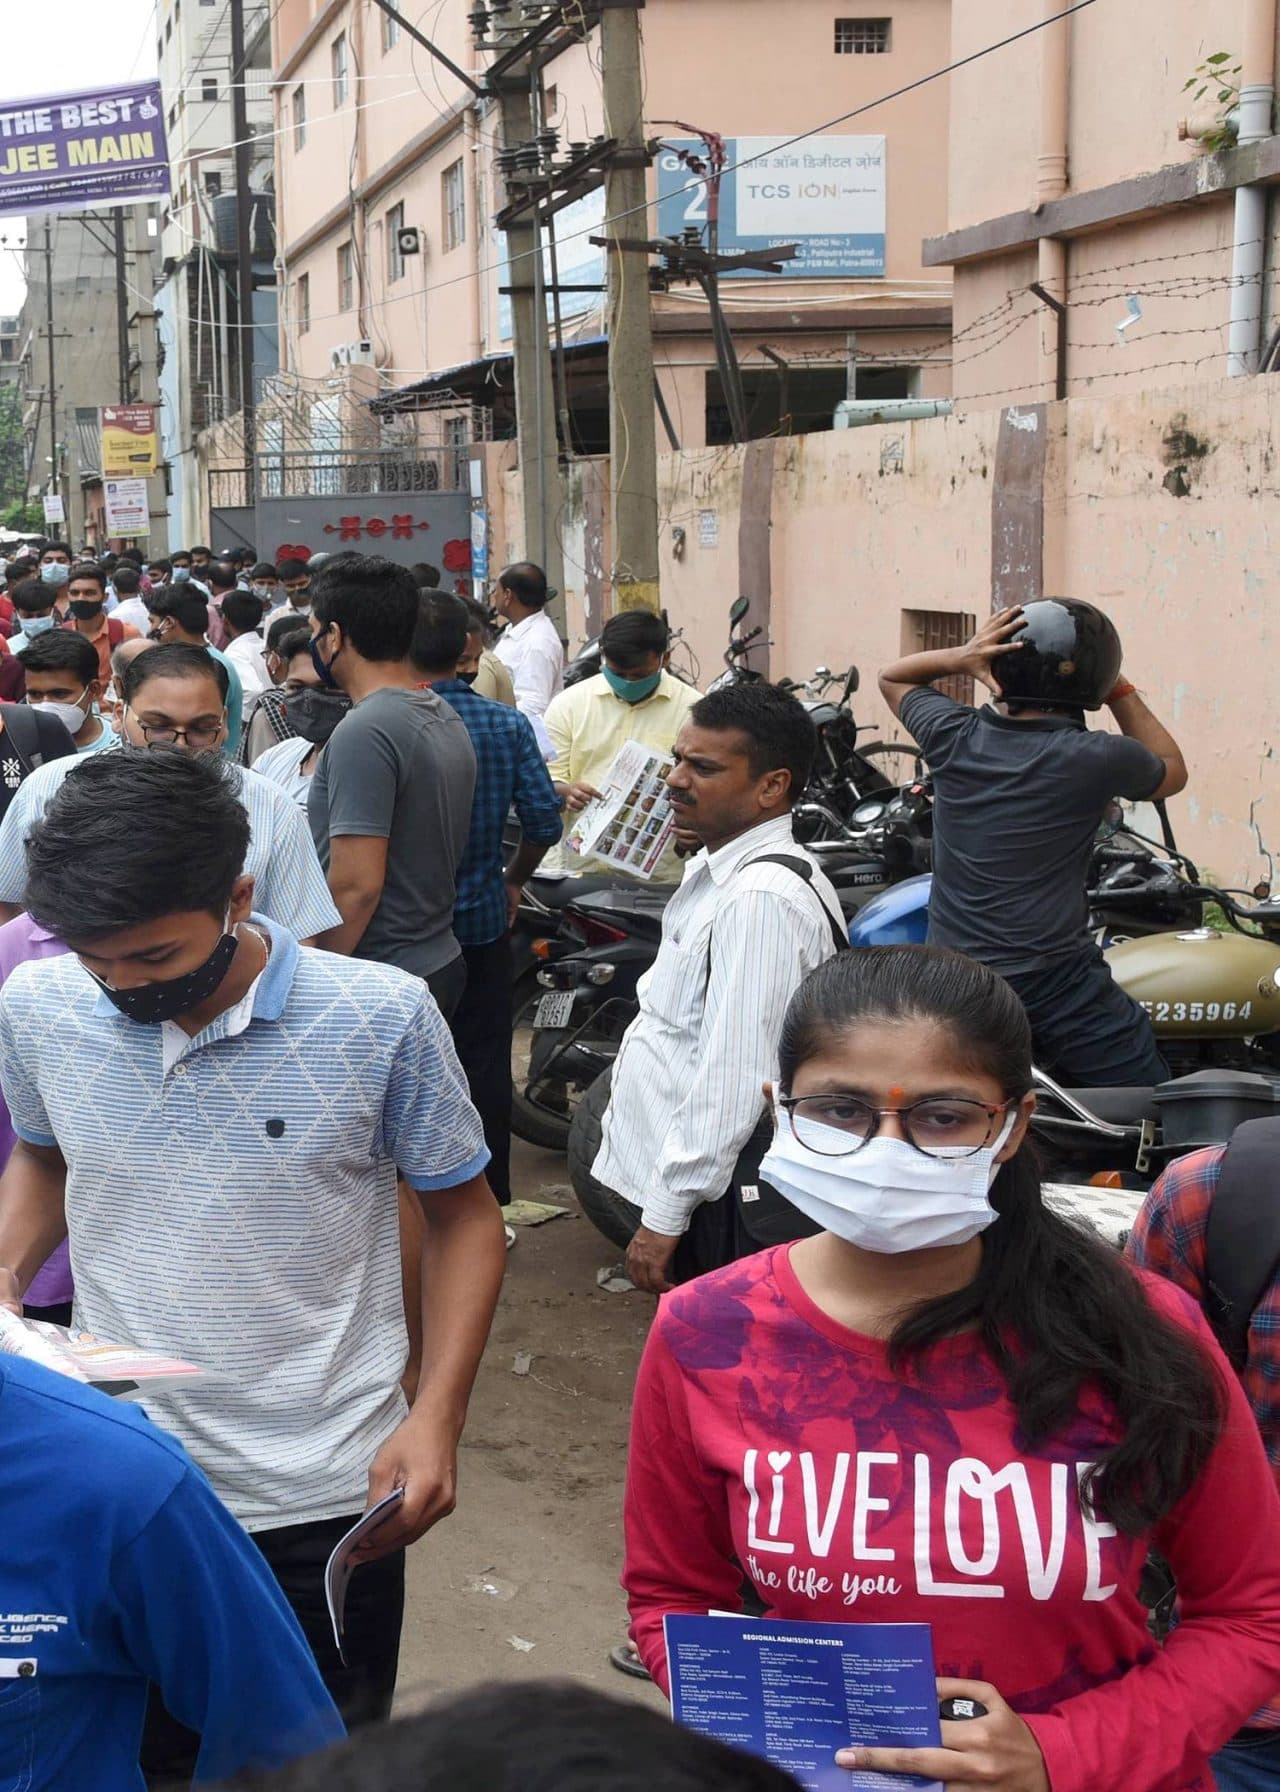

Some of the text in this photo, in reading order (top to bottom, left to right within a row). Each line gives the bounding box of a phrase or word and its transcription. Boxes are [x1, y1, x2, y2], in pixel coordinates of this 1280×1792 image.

[62, 98, 134, 130] BEST
[0, 144, 58, 176] JEE
[67, 132, 155, 167] MAIN
[684, 178, 707, 220] 2
[747, 184, 790, 199] TCS
[914, 1453, 1118, 1601] LOVE
[747, 1554, 902, 1606] the life you
[11, 1624, 58, 1633] WEAR
[742, 1634, 844, 1647] REGIONAL ADMISSION CENTERS
